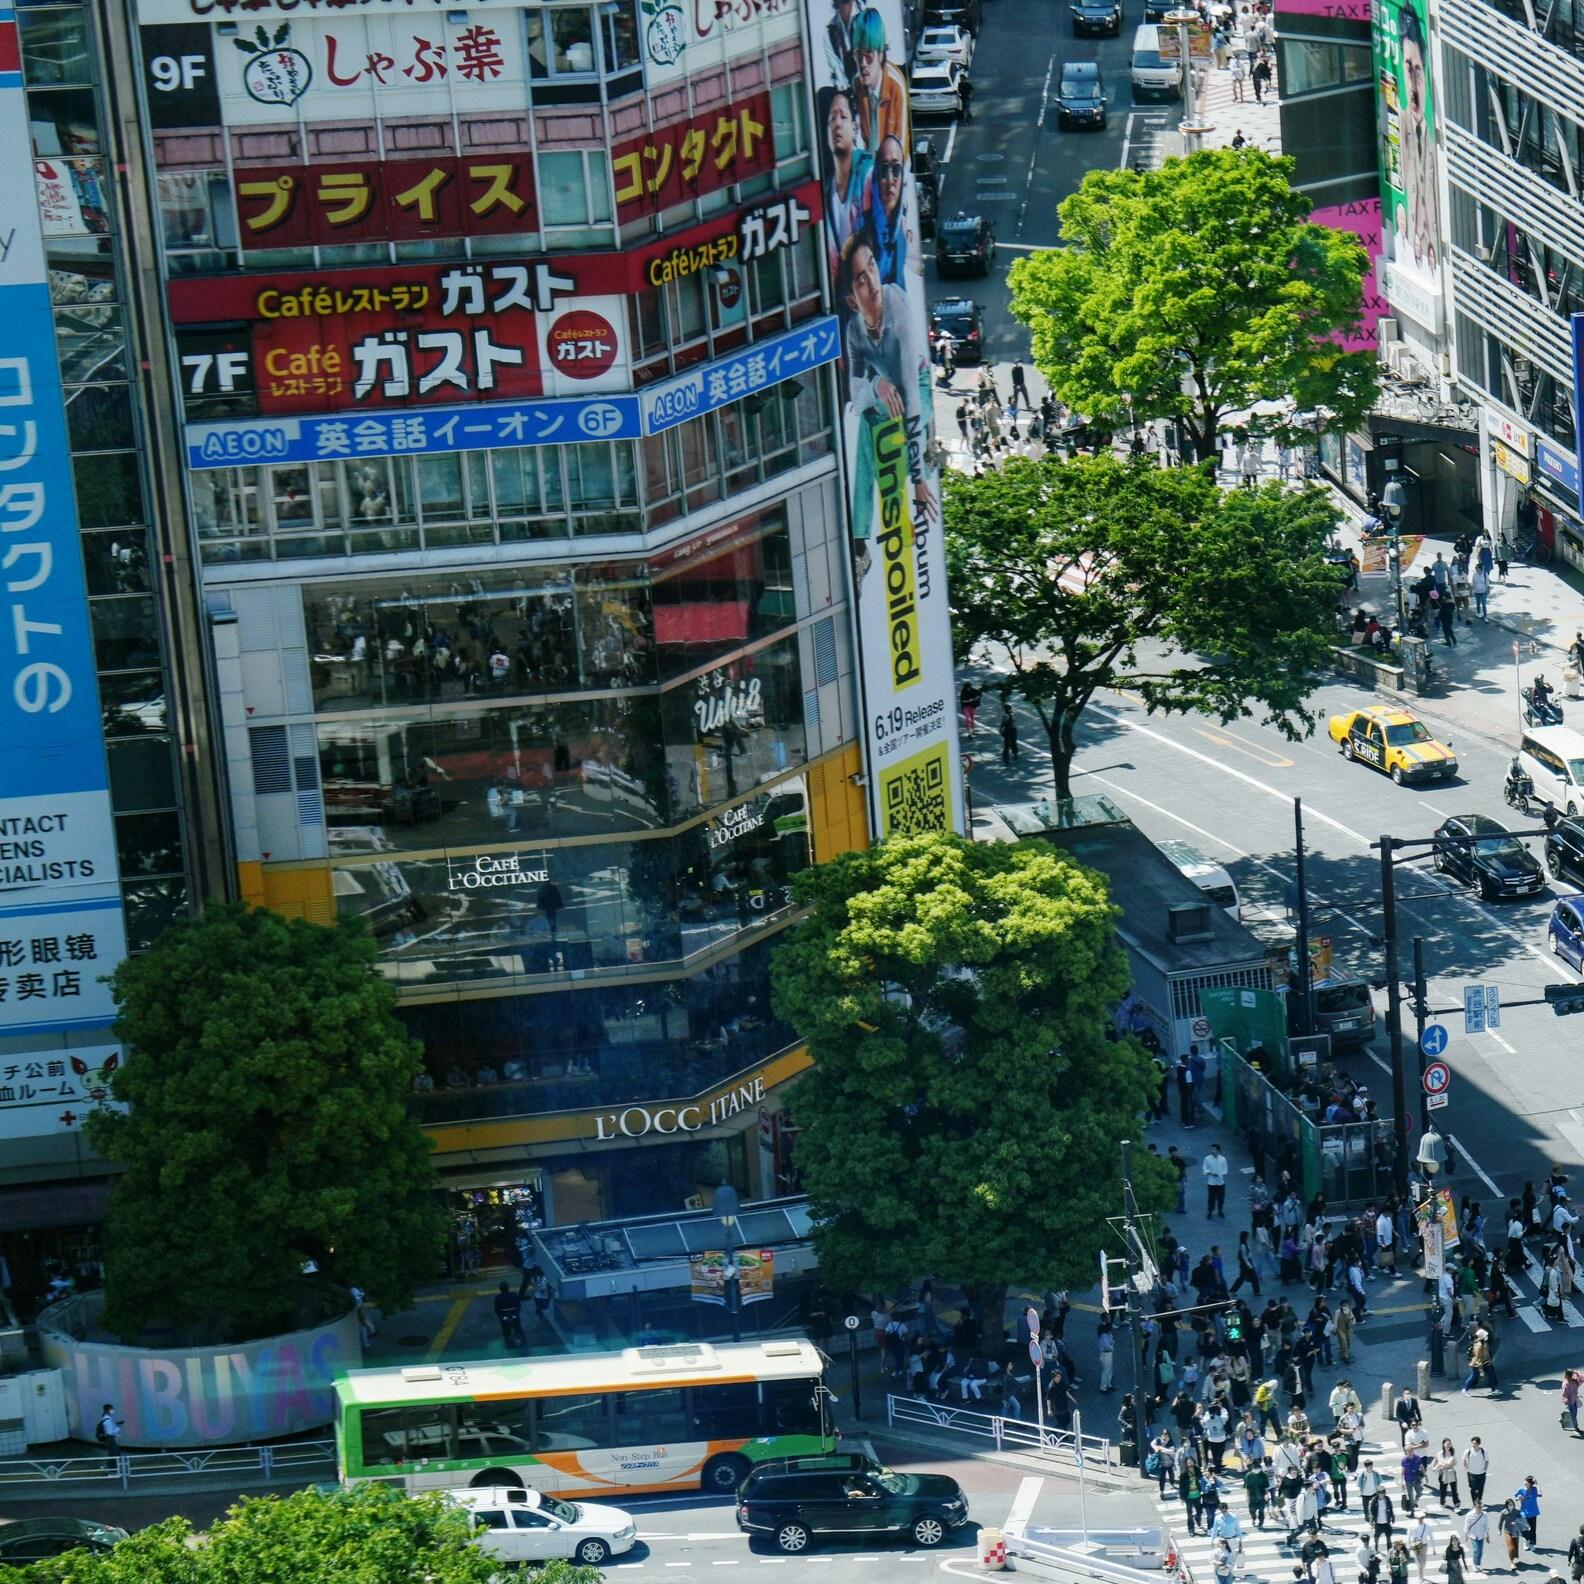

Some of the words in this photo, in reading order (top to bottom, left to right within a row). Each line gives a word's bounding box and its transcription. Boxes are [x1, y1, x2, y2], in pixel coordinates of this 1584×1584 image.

[1324, 5, 1362, 20] TAX
[151, 56, 205, 90] 9F
[325, 25, 504, 86] しゃぶ葉
[613, 109, 764, 203] コンタクト
[239, 164, 526, 230] プライス
[1336, 201, 1370, 217] TAX
[742, 199, 809, 261] ガスト
[441, 264, 575, 317] ガスト
[183, 353, 248, 392] 7F
[266, 346, 341, 376] Café
[353, 330, 522, 399] ガスト
[557, 341, 610, 361] ガスト
[653, 384, 698, 425] AEON
[709, 329, 835, 404] 英会話イーオン
[270, 379, 342, 396] レストラン
[205, 430, 286, 457] AEON
[315, 414, 564, 455] 英会話イーオン
[584, 405, 618, 429] 6F
[907, 414, 924, 486] New
[875, 424, 920, 689] Unspoiled
[911, 498, 932, 600] Album
[875, 706, 904, 742] 6.19
[905, 698, 945, 724] Release
[449, 870, 549, 890] L'OCCITANE
[595, 1076, 766, 1141] L'OCCITANE
